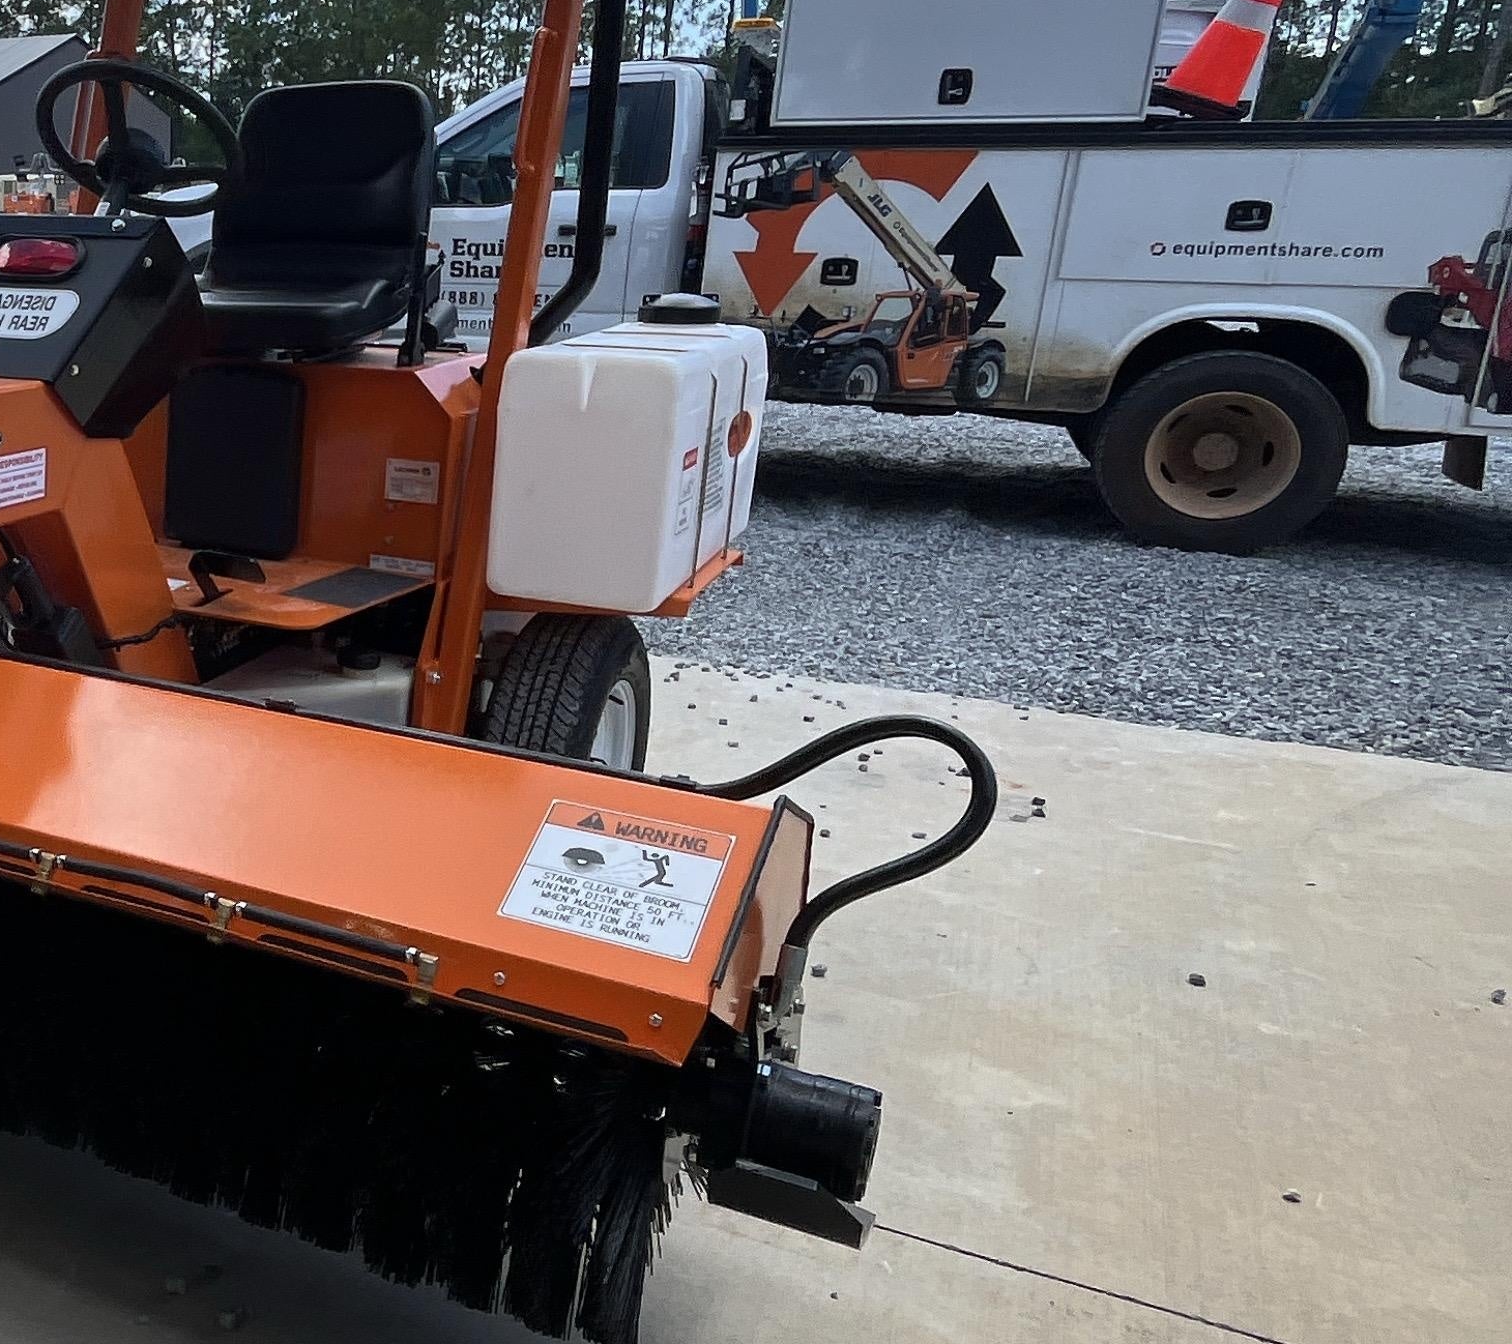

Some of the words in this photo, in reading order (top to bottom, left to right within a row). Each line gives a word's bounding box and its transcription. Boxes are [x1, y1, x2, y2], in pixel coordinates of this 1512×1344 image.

[1172, 241, 1385, 258] equipmentshare.com
[614, 821, 708, 853] WARNING
[532, 878, 580, 896] MINIMUM
[585, 892, 640, 910] DISTANCE
[646, 906, 662, 916] 50
[544, 871, 577, 886] STAND
[582, 881, 618, 896] CLEAR
[623, 890, 638, 899] OF
[541, 891, 569, 904] WHEN
[573, 898, 624, 917] MACHINE
[630, 910, 644, 922] IS
[650, 916, 666, 927] IN
[555, 903, 621, 927] OPERATION
[625, 920, 642, 931] OR
[532, 907, 573, 925] ENGINE
[580, 919, 594, 930] IS
[600, 924, 651, 944] RUNNING
